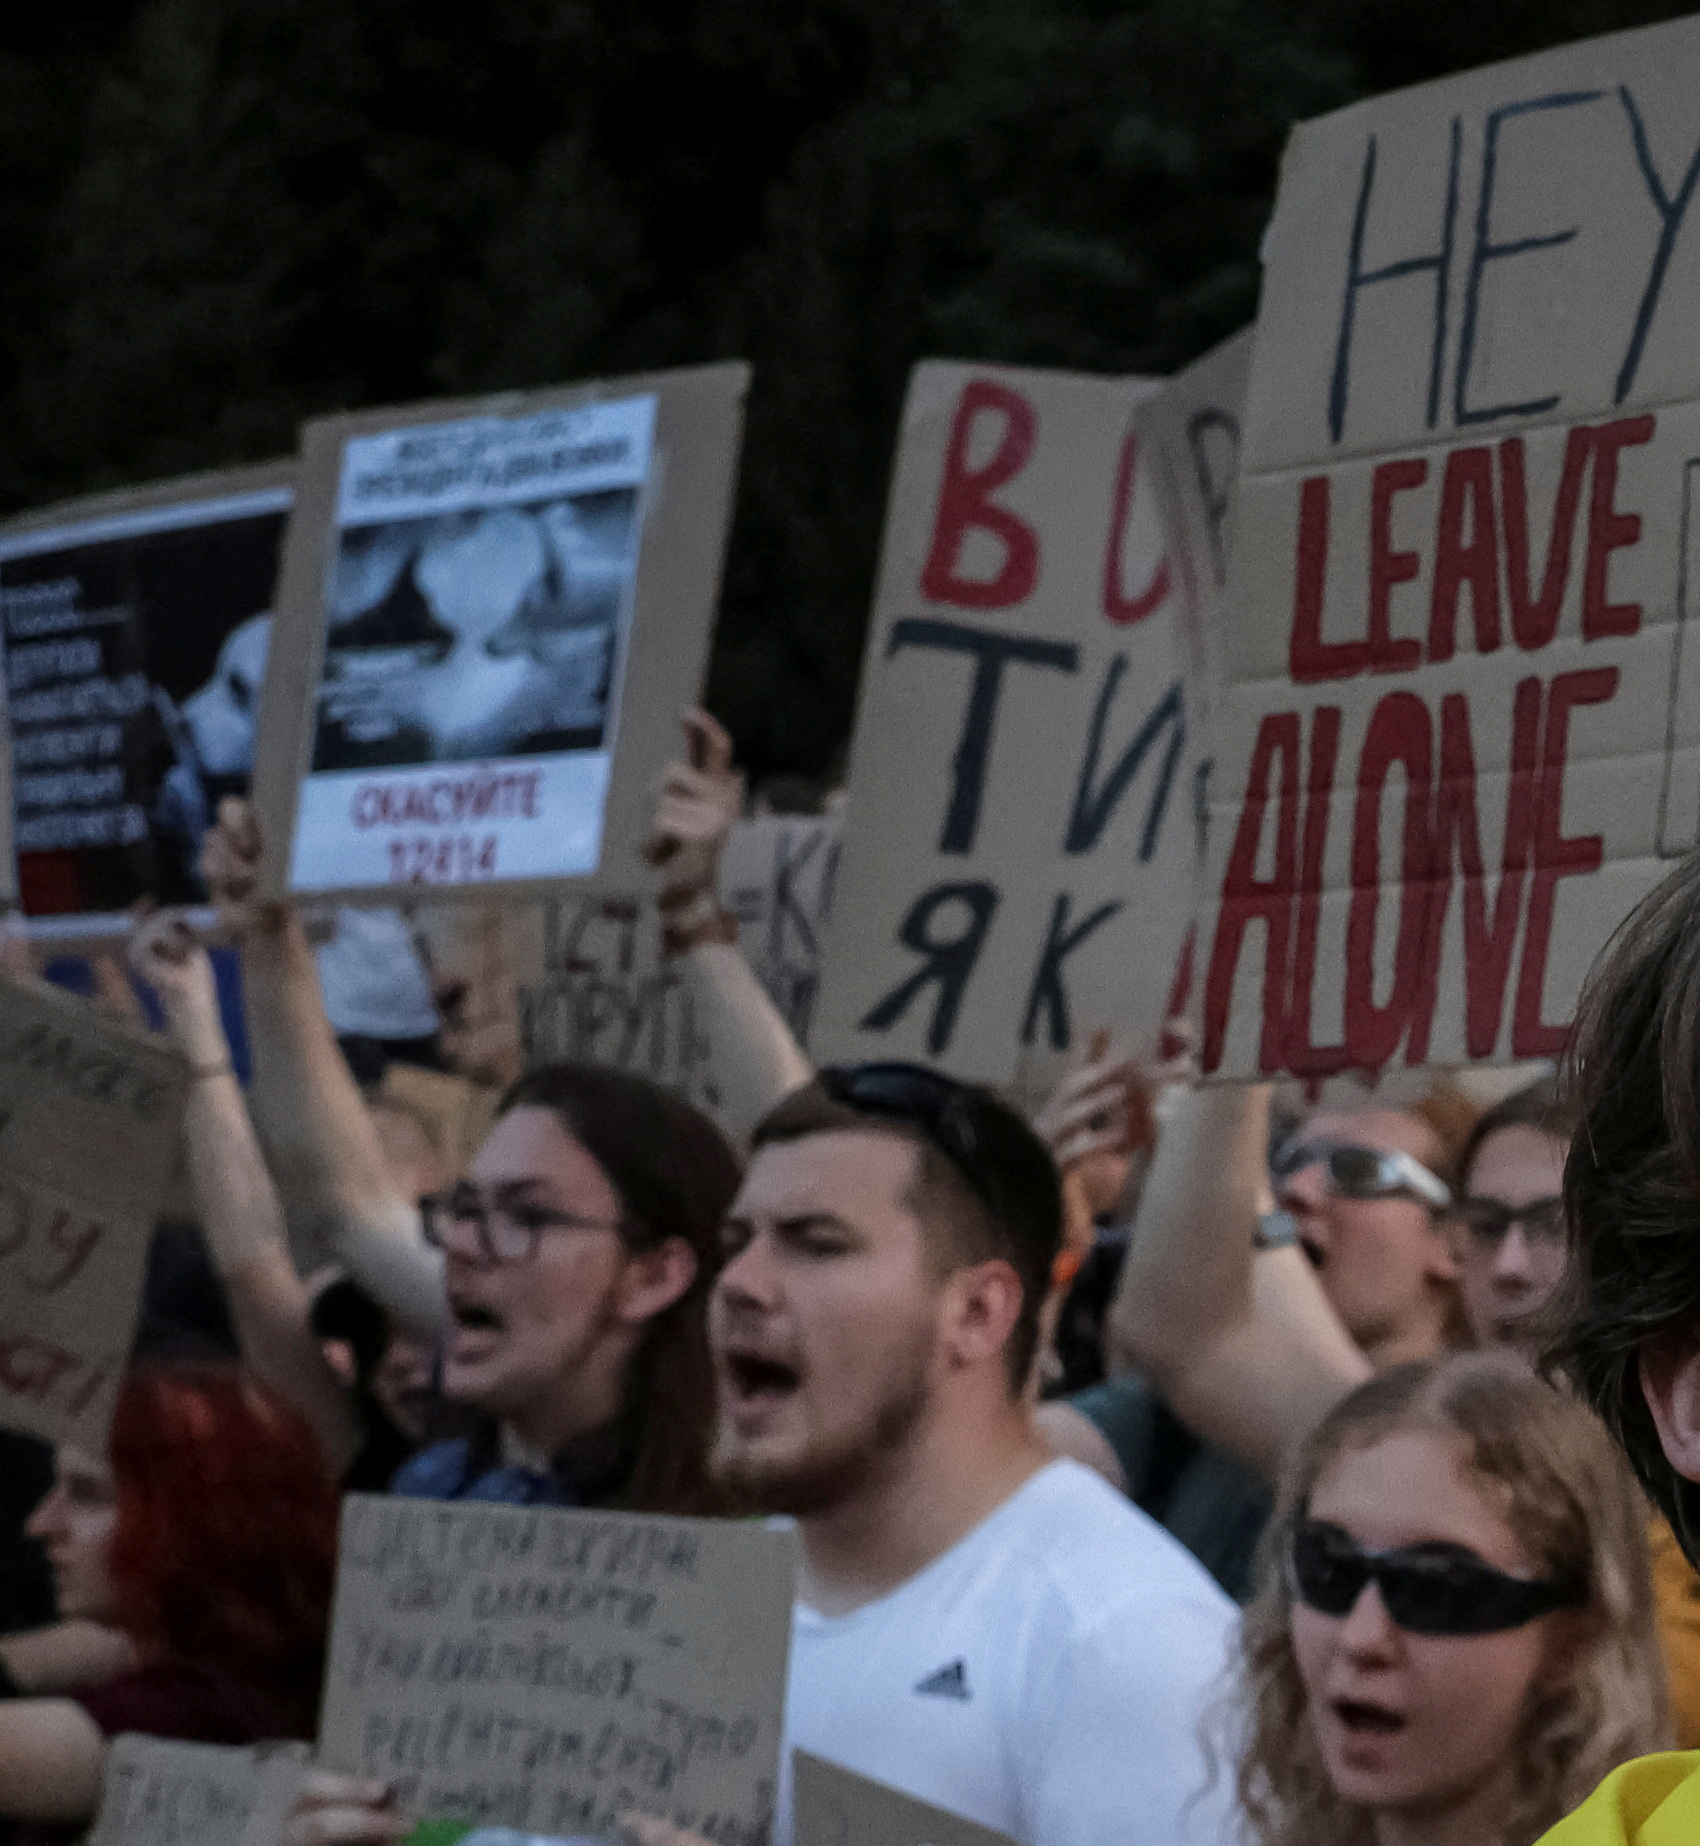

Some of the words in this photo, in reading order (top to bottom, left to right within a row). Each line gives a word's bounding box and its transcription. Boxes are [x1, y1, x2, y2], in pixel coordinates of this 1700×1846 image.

[1289, 414, 1656, 683] LEAVE
[860, 881, 1126, 1055] ЯК
[1202, 667, 1620, 1078] ALONE
